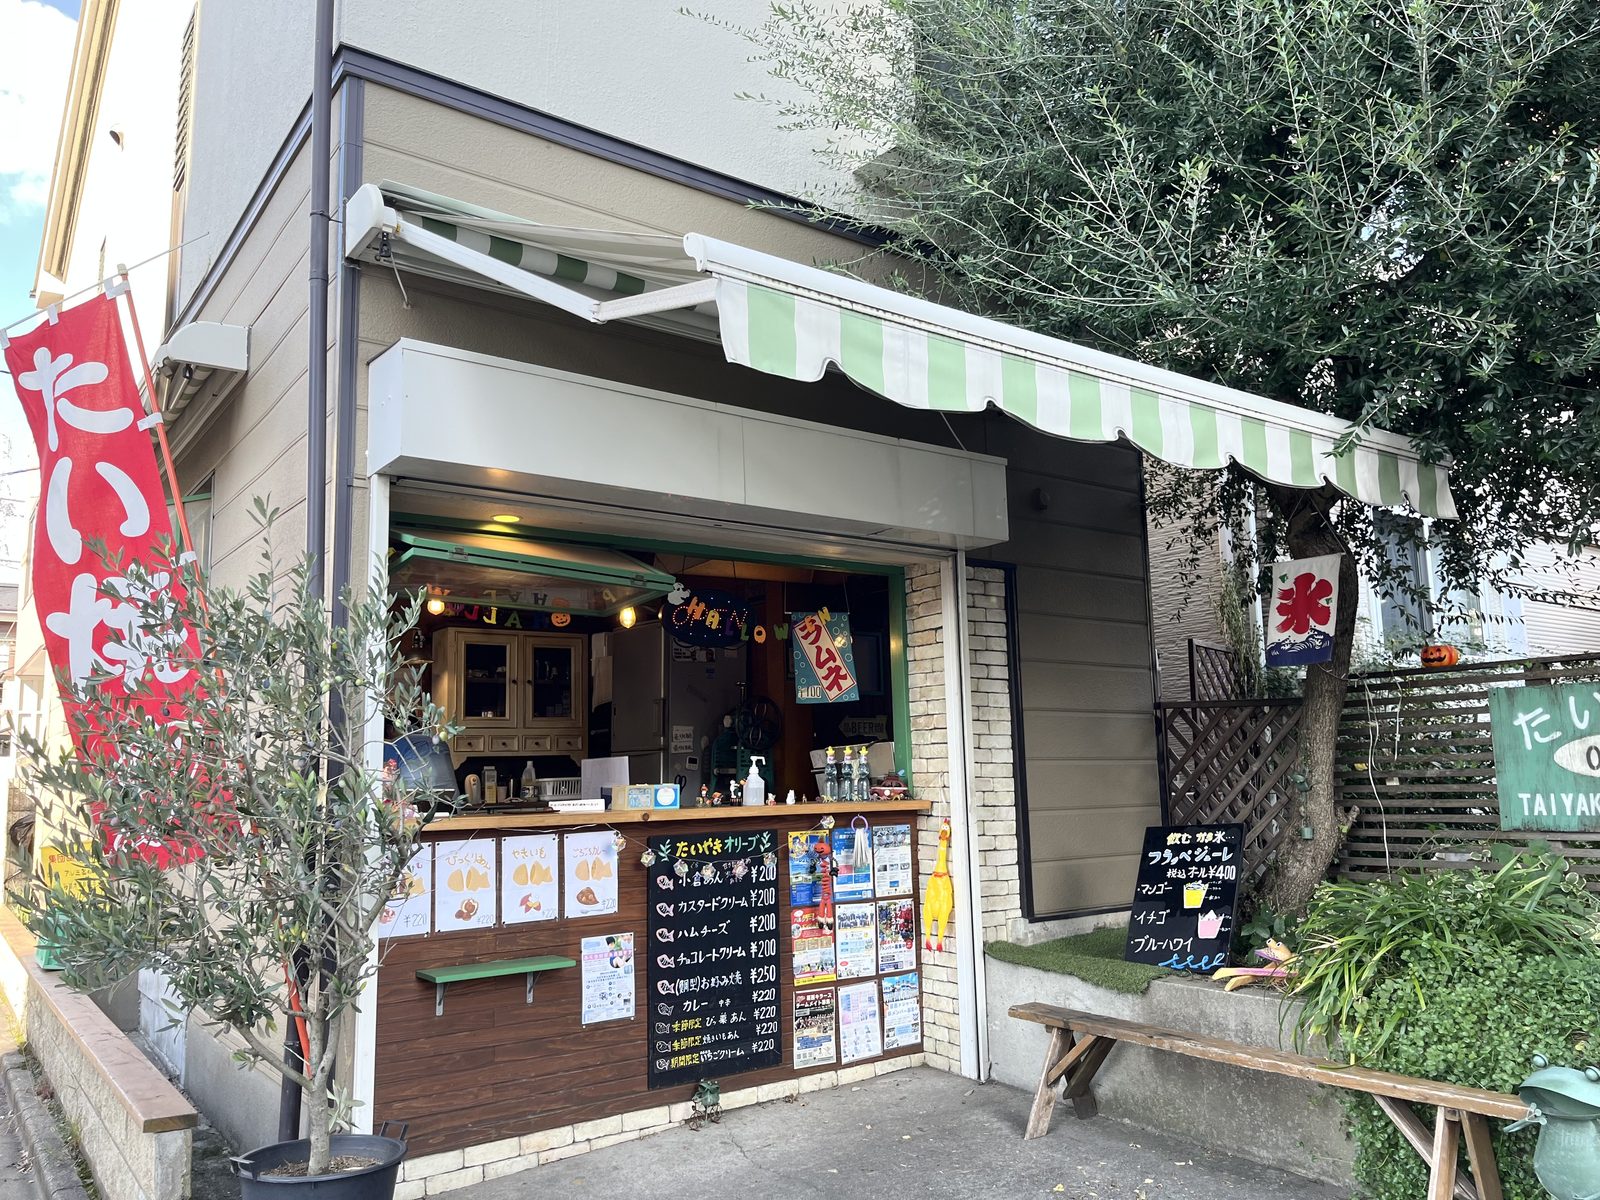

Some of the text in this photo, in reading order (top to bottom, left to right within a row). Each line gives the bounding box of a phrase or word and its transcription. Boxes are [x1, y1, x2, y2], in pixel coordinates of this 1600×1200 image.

[1276, 572, 1334, 635] 氷
[798, 618, 848, 692] ラムネ
[512, 847, 547, 860] やきいも
[675, 834, 760, 857] たいやき オリーブ
[750, 864, 777, 883] ¥200
[678, 896, 749, 914] カスタードクリーム
[750, 887, 776, 907] ¥200
[403, 913, 428, 929] ¥220
[677, 920, 731, 938] ハムチーズ
[749, 912, 776, 933] ¥200
[676, 946, 747, 966] チョコレートクリーム
[750, 938, 777, 958] ¥200
[750, 964, 777, 985] ¥250
[682, 999, 709, 1012] カレー
[751, 988, 776, 1002] ¥220
[671, 1017, 702, 1033] 季節限定
[753, 1005, 777, 1020] ¥220
[671, 1035, 702, 1052] 季節限定
[755, 1021, 778, 1036] ¥220
[670, 1053, 700, 1069] 期間限定
[751, 1038, 775, 1054] ¥220
